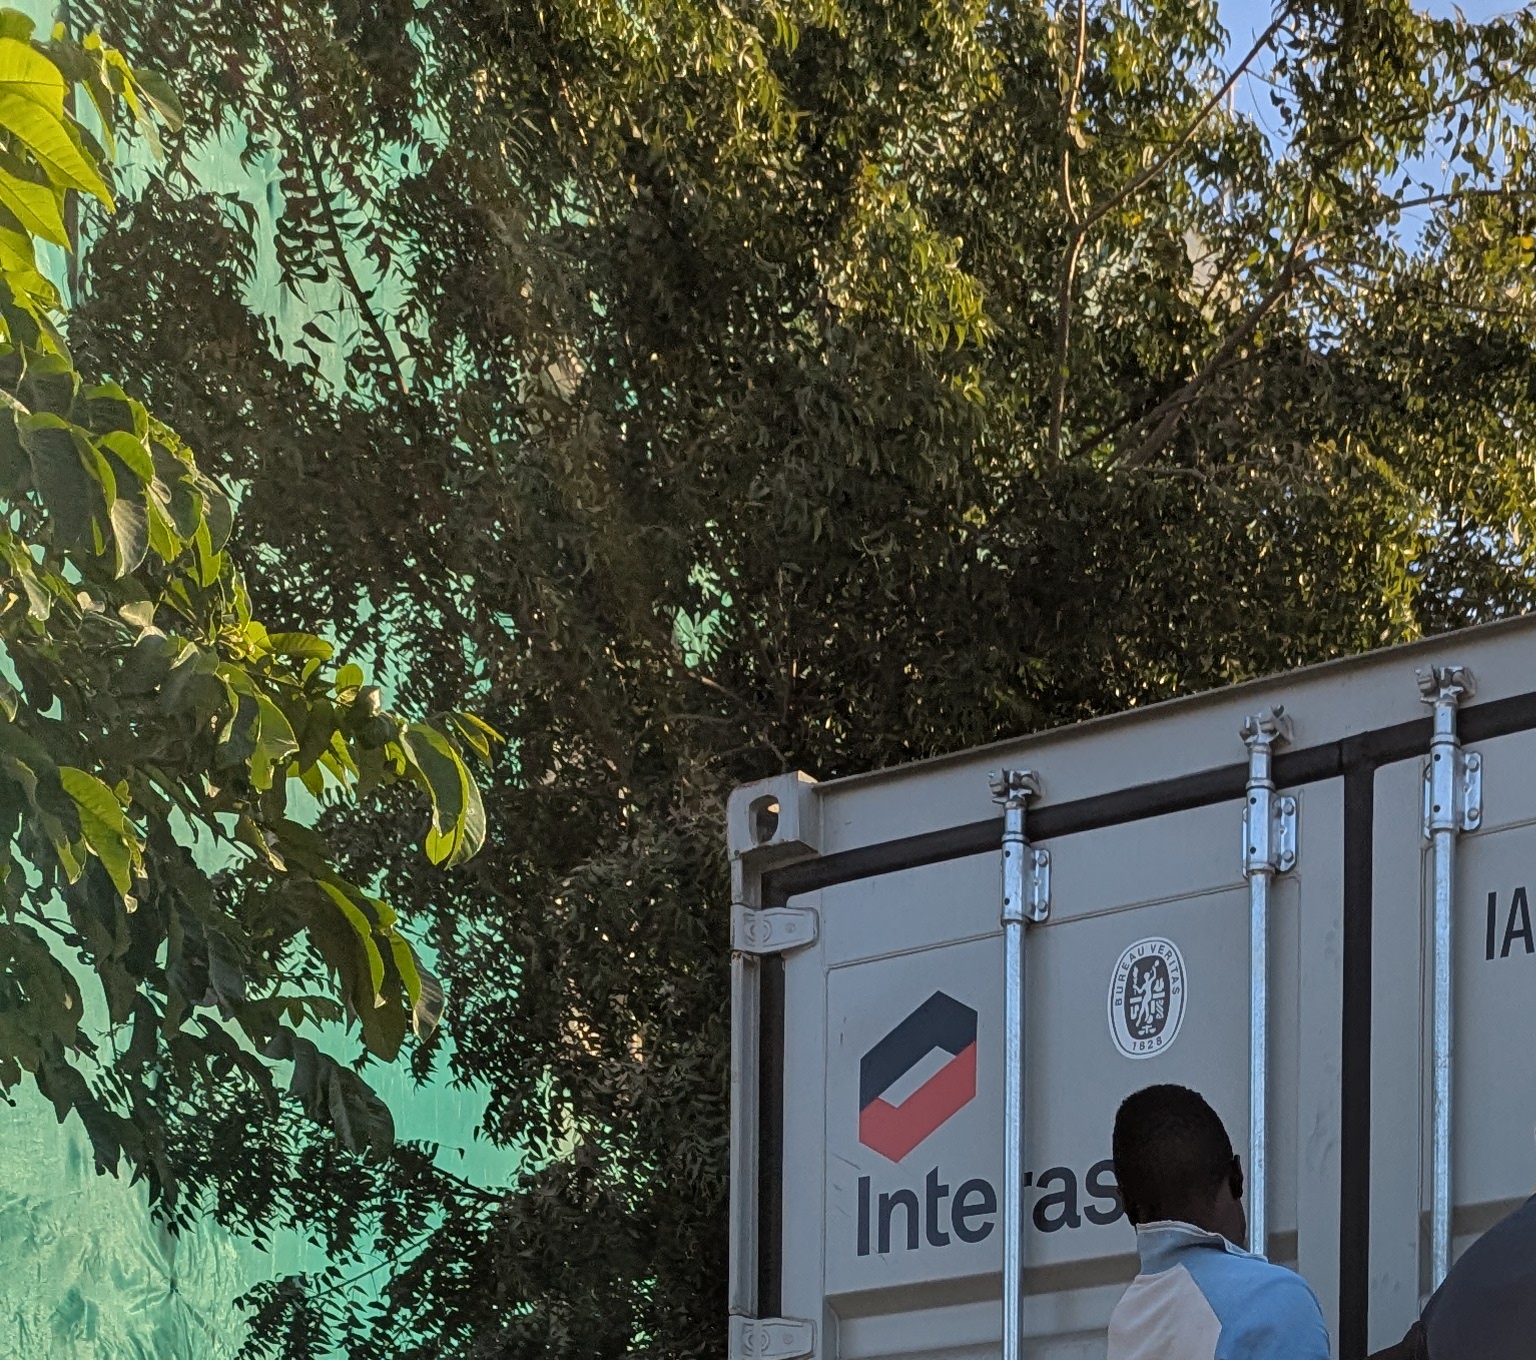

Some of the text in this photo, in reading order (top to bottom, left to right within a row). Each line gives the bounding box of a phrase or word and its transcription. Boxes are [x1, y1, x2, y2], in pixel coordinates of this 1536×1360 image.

[1115, 943, 1180, 1006] BUREAU VERITAS
[1132, 1036, 1163, 1051] 1828
[857, 1159, 1126, 1257] Inteas
